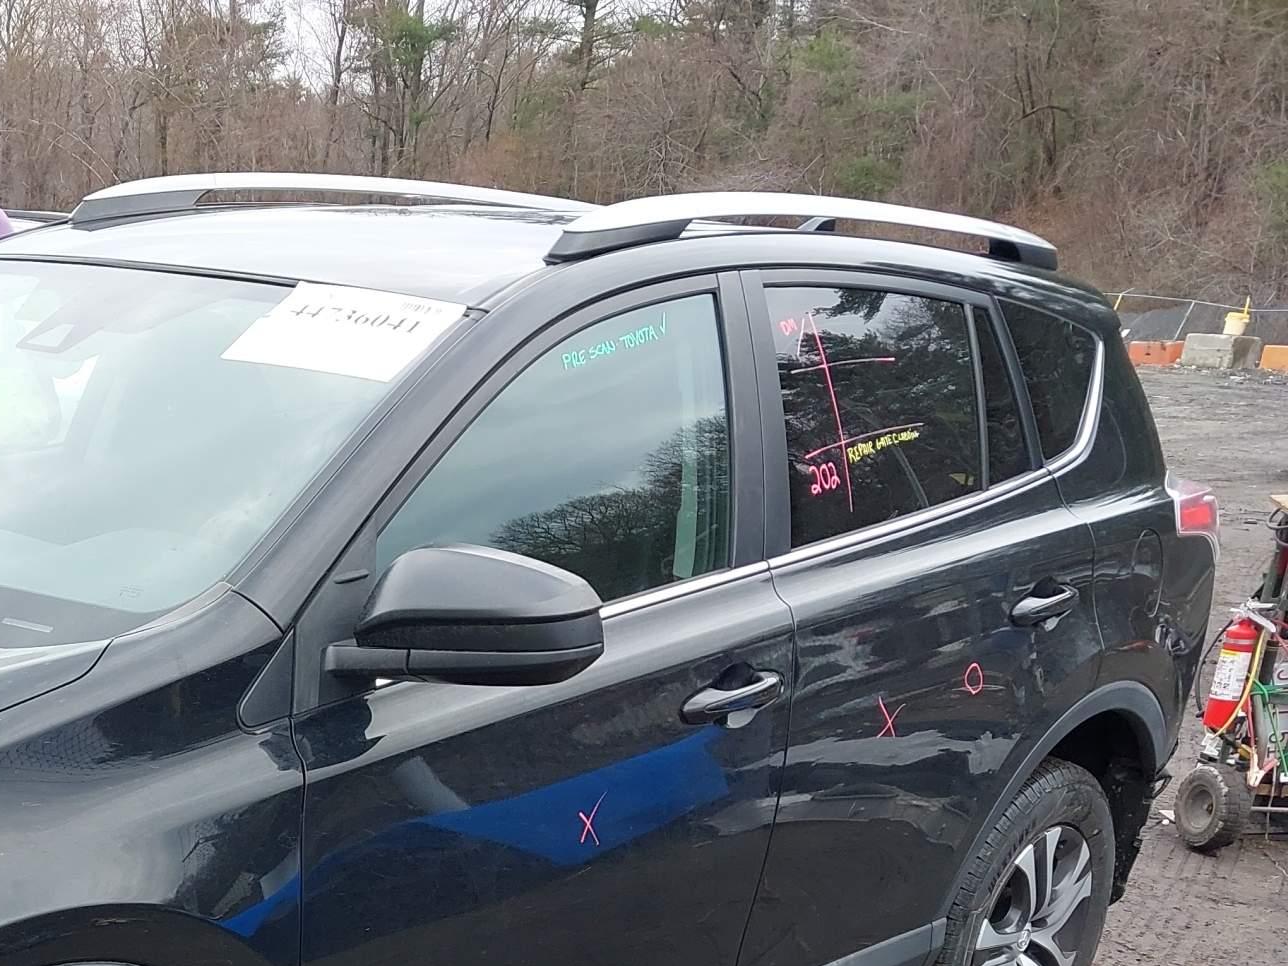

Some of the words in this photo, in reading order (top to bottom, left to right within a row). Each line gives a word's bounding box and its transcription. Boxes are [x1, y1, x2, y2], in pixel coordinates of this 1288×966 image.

[562, 350, 585, 370] PRE
[619, 325, 658, 349] TOYOTA
[809, 462, 841, 495] 202
